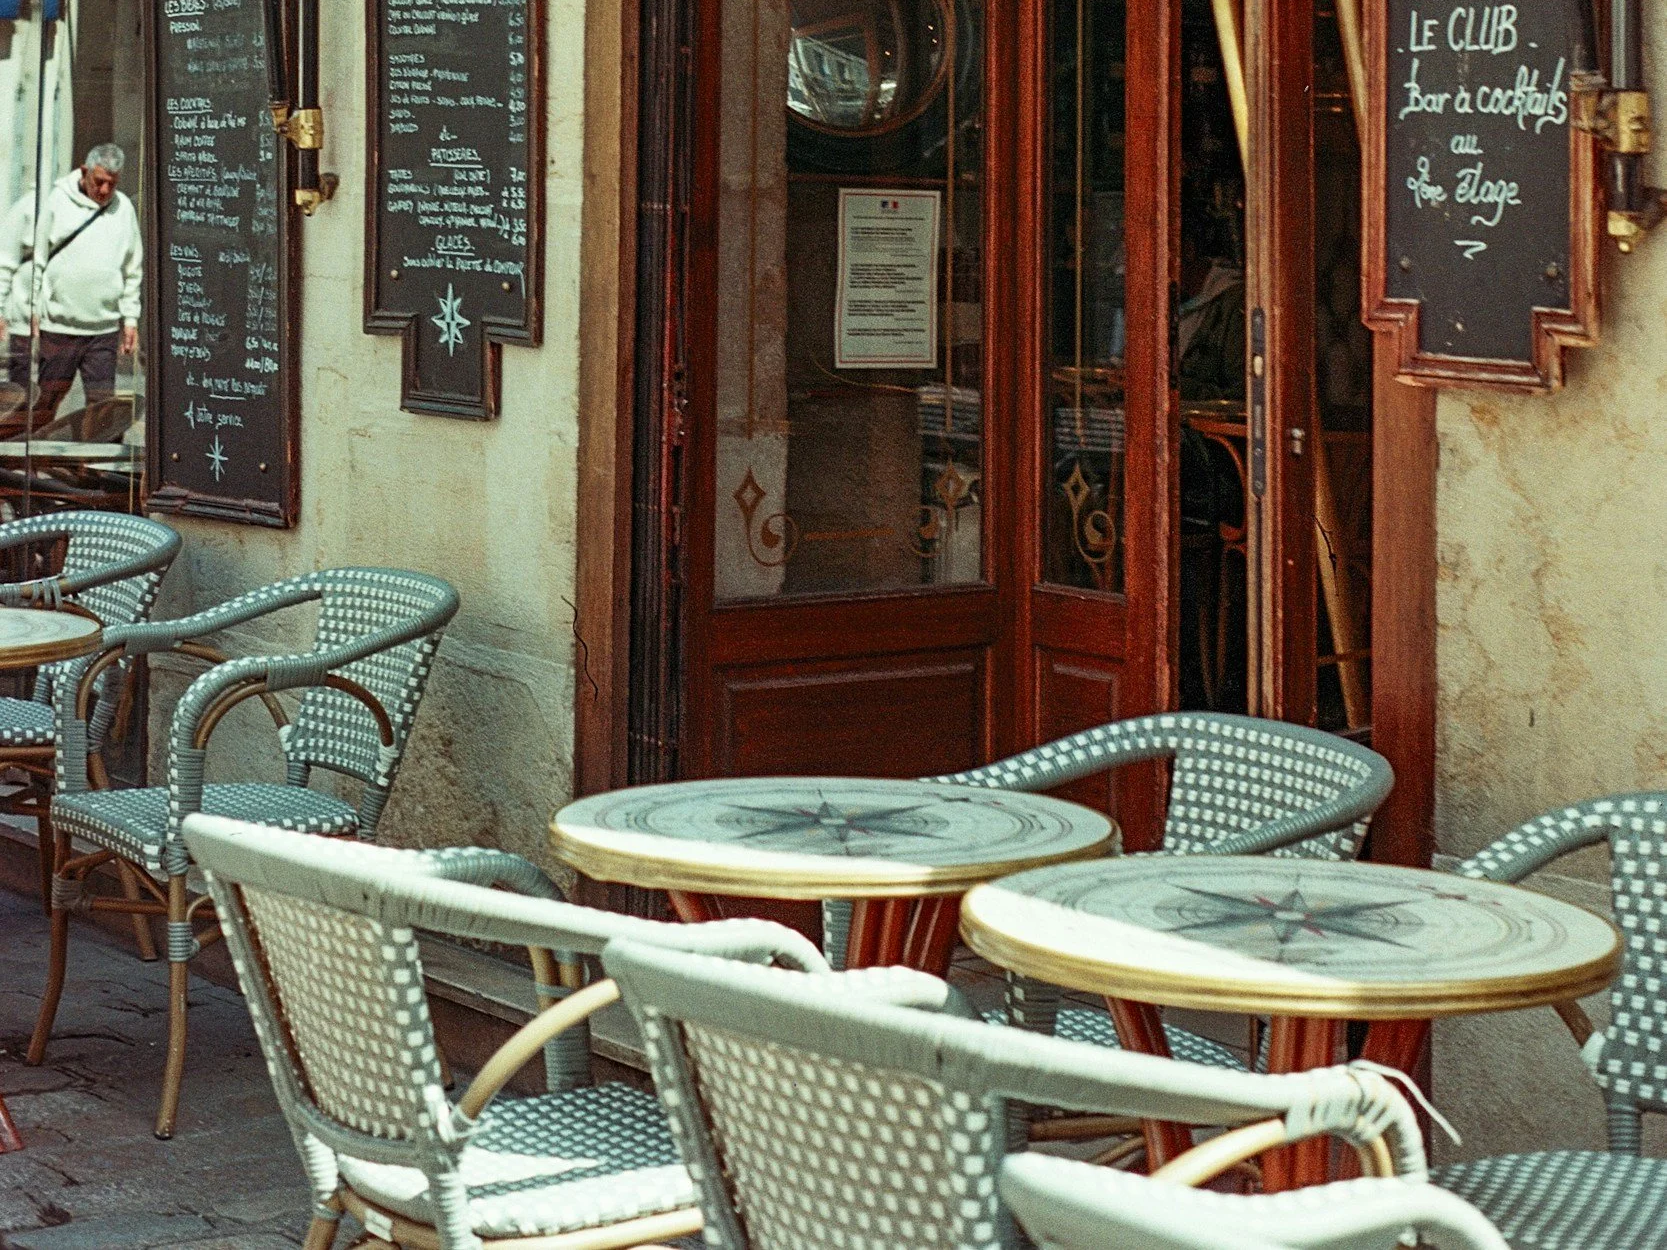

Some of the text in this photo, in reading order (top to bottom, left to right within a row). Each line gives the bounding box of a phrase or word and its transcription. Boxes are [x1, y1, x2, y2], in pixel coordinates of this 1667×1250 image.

[1410, 4, 1518, 55] LE CLUB
[1450, 134, 1484, 155] au
